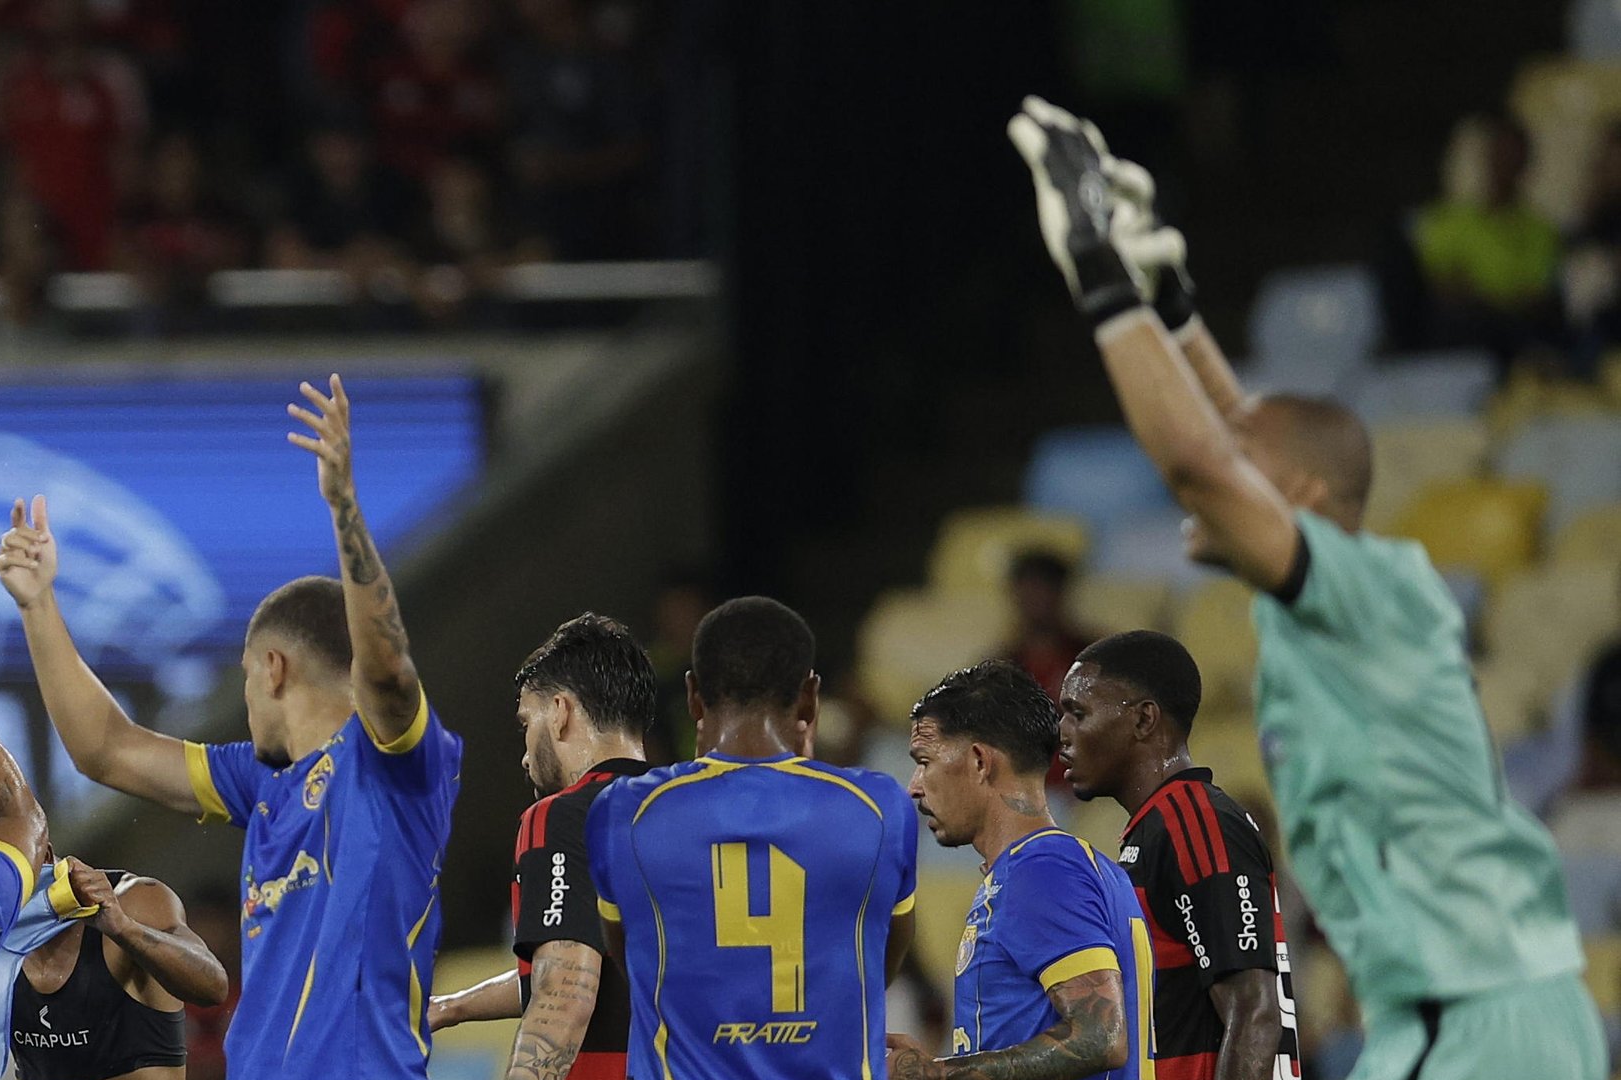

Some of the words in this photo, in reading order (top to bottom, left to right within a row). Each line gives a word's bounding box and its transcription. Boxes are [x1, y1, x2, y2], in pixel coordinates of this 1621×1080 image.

[542, 851, 570, 927] Shopee
[711, 841, 806, 1013] 4
[1236, 874, 1259, 951] Shopee
[1174, 893, 1211, 970] Shopee
[13, 1029, 90, 1048] CATAPULT
[712, 1020, 818, 1045] PRATIC
